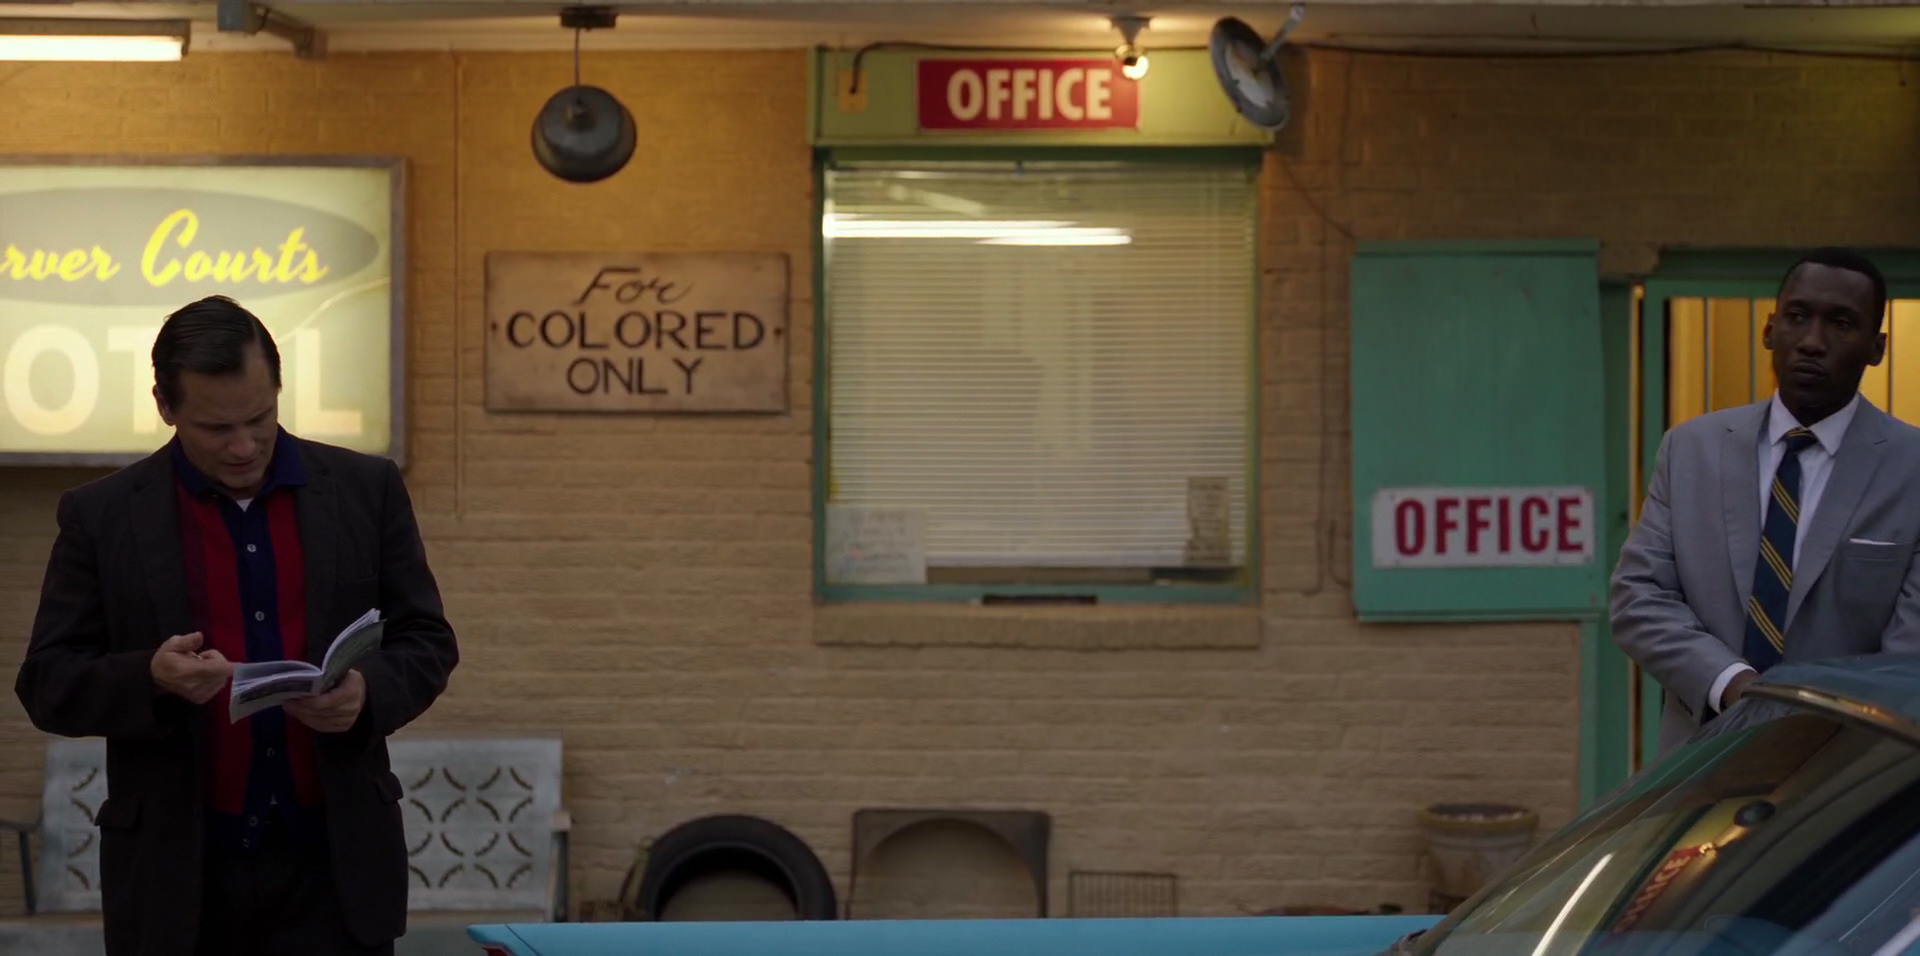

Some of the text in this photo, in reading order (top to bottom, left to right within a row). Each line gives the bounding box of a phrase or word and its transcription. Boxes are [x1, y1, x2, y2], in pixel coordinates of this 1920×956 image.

[946, 68, 1113, 121] OFFICE
[0, 209, 329, 286] rver Courts
[572, 265, 692, 306] For
[506, 310, 766, 350] COLORED
[3, 324, 363, 436] OTL
[565, 357, 705, 395] ONLY
[1394, 496, 1584, 557] OFFICE
